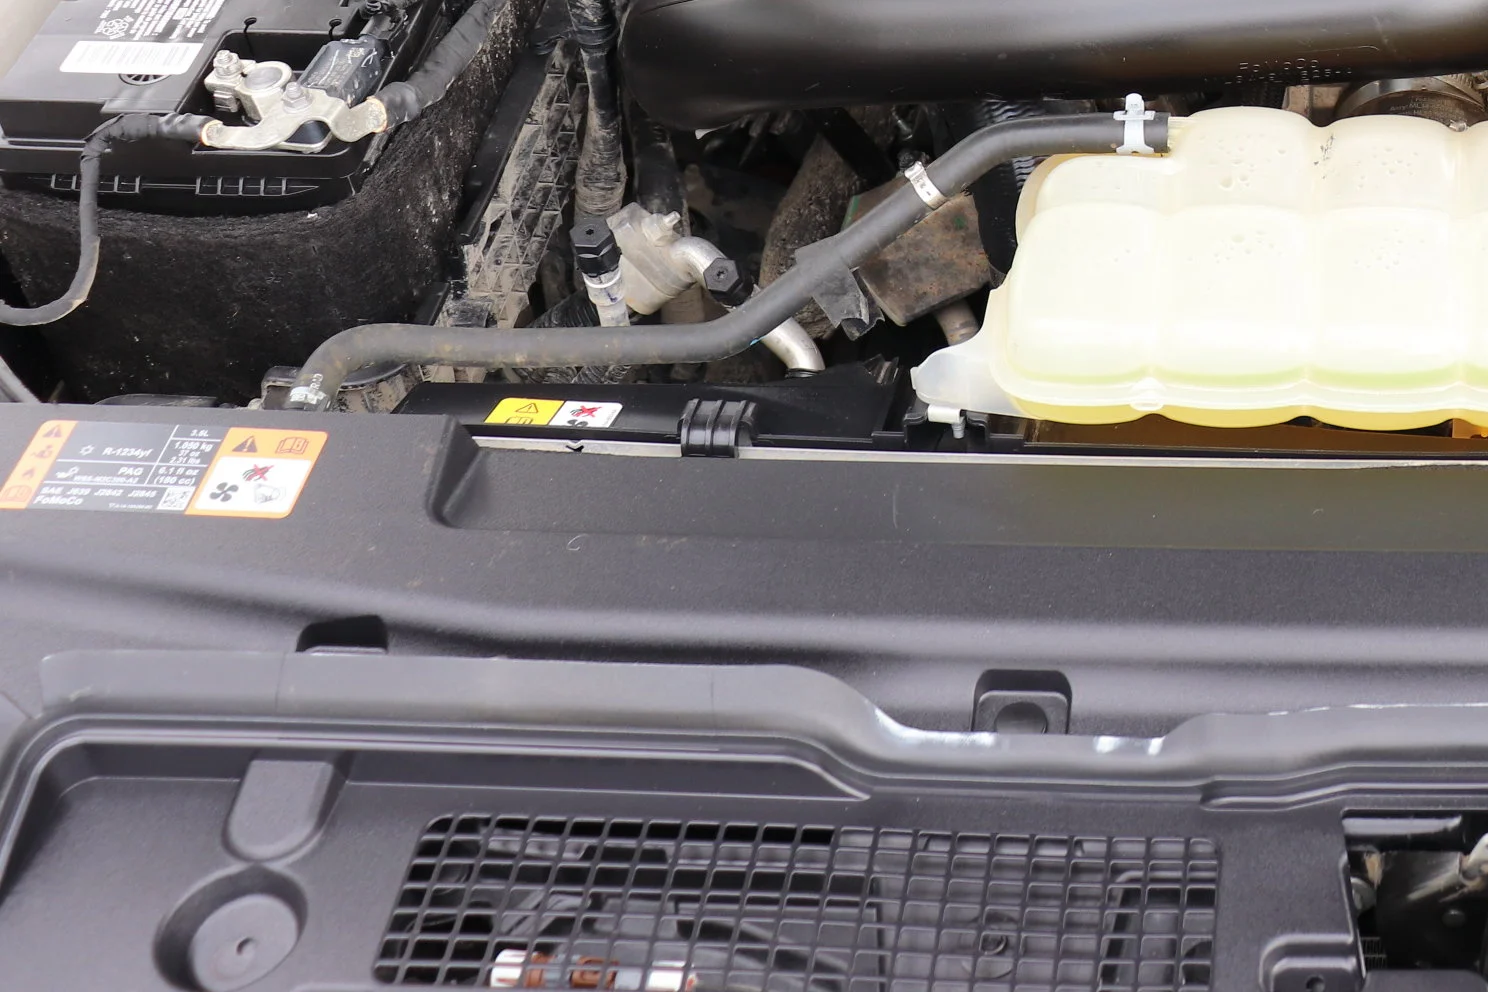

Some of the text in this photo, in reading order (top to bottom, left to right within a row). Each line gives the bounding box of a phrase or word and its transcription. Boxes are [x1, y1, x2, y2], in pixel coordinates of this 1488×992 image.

[200, 442, 214, 452] kg
[102, 447, 154, 459] R-1234yf
[118, 467, 143, 475] PAG
[158, 467, 174, 475] 6.1
[41, 486, 64, 494] SAE
[66, 488, 91, 496] J639
[33, 496, 83, 505] FoMoCo
